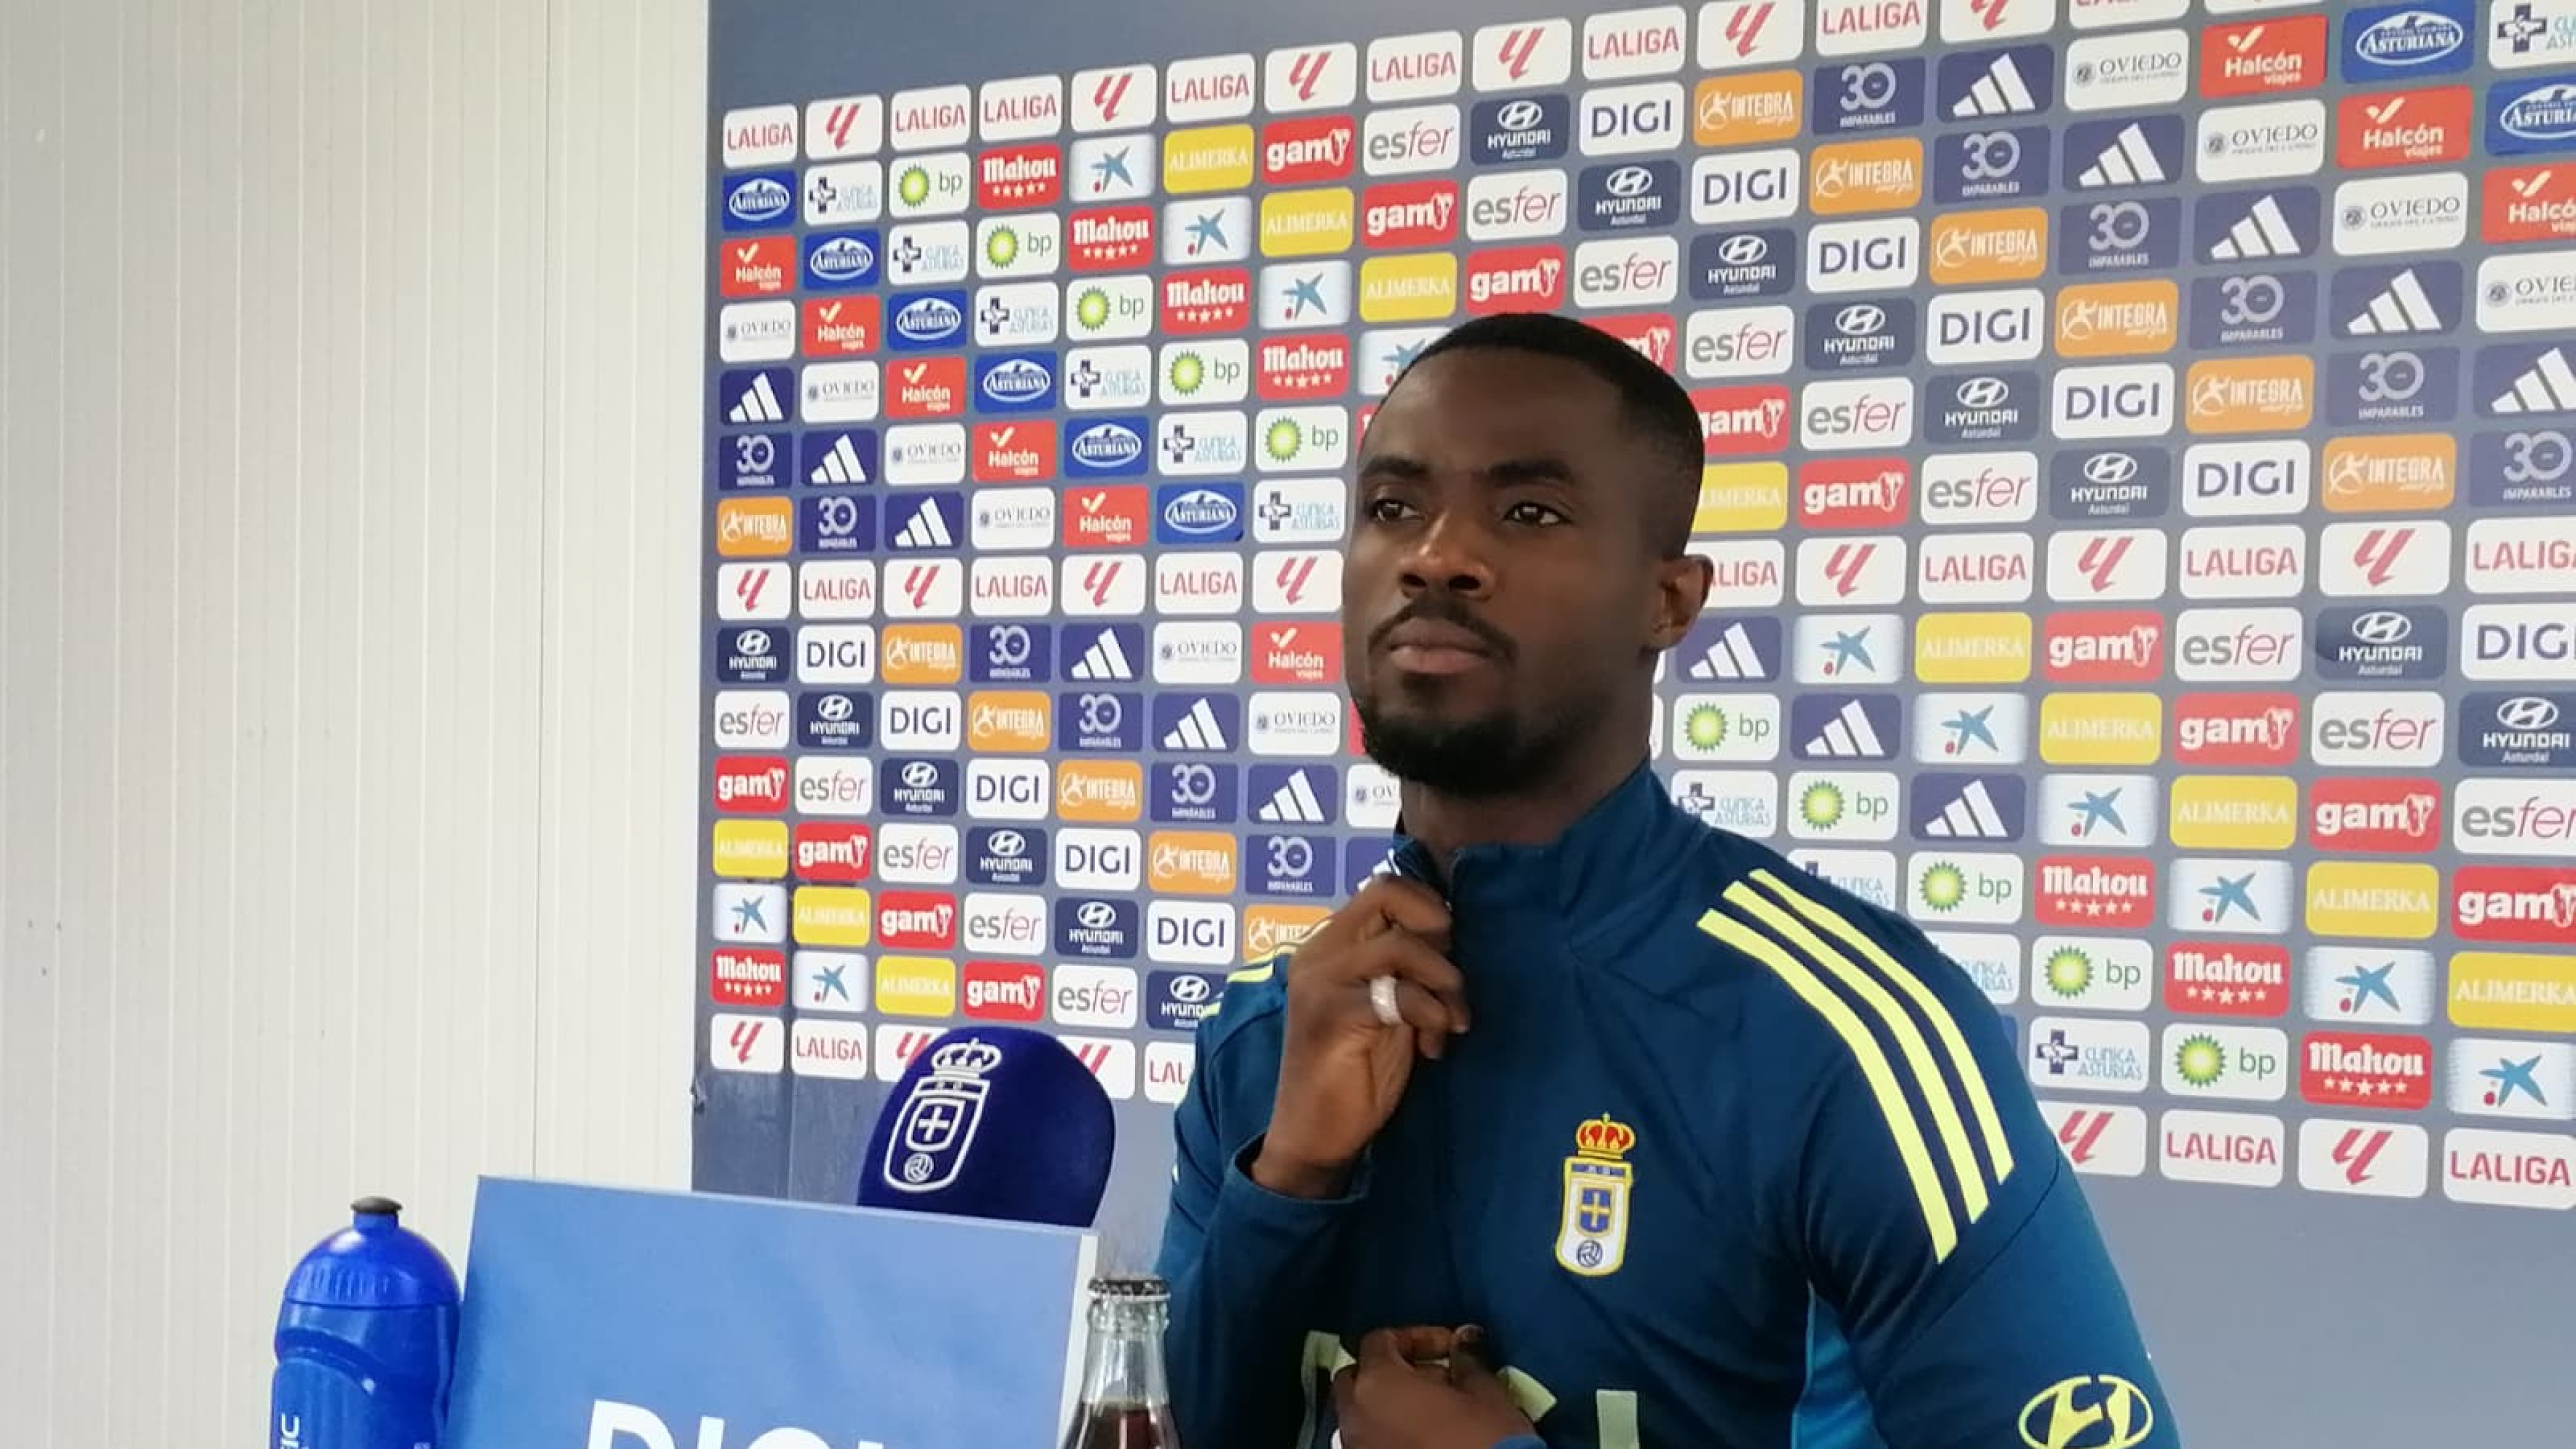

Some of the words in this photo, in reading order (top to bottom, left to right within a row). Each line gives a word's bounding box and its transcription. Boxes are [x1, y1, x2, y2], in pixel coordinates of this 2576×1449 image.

[1823, 1, 1919, 34] LALIGA
[1588, 25, 1680, 60] LALIGA
[1371, 50, 1456, 83] LALIGA
[2100, 52, 2181, 76] OVIEDO
[2224, 48, 2302, 78] Halcón
[1171, 72, 1250, 104] LALIGA
[1840, 61, 1897, 111] 30
[895, 103, 966, 132] LALIGA
[984, 93, 1057, 123] LALIGA
[1592, 100, 1671, 139] DIGI
[1730, 89, 1794, 119] INTEGRA
[727, 122, 793, 150] LALIGA
[1369, 117, 1454, 161] esfer
[1487, 129, 1551, 148] HYUNDAI
[2233, 123, 2317, 146] OVIEDO
[2363, 120, 2445, 150] Halcón
[983, 152, 1055, 182] Mahou
[1962, 129, 2021, 180] 30
[938, 169, 962, 197] bp
[1704, 168, 1786, 206] DIGI
[1848, 157, 1915, 187] INTEGRA
[1473, 183, 1562, 226] esfer
[1596, 196, 1662, 215] HYUNDAI
[2371, 197, 2459, 219] OVIEDO
[1073, 213, 1148, 244] Mahou
[2088, 200, 2150, 251] 30
[1027, 229, 1052, 258] bp
[1820, 236, 1906, 274] DIGI
[1970, 227, 2039, 257] INTEGRA
[1580, 250, 1672, 293] esfer
[1707, 265, 1776, 283] HYUNDAI
[1118, 292, 1144, 320] bp
[1166, 276, 1244, 307] Mahou
[2220, 274, 2285, 325] 30
[1940, 308, 2029, 345] DIGI
[2097, 300, 2169, 329] INTEGRA
[1263, 342, 1344, 372] Mahou
[1692, 321, 1787, 363] esfer
[1824, 336, 1895, 354] HYUNDAI
[1214, 356, 1240, 384] bp
[2358, 350, 2425, 402] 30
[2066, 383, 2159, 421] DIGI
[2229, 376, 2305, 405] INTEGRA
[1807, 392, 1907, 435] esfer
[1945, 409, 2019, 427] HYUNDAI
[1311, 423, 1339, 451] bp
[737, 434, 773, 472] 30
[2503, 430, 2573, 482] 30
[2197, 460, 2294, 497] DIGI
[2367, 455, 2446, 484] INTEGRA
[1928, 466, 2031, 508] esfer
[2070, 486, 2147, 502] HYUNDAI
[818, 496, 857, 535] 30
[1925, 554, 2027, 582] LALIGA
[2186, 547, 2298, 576] LALIGA
[803, 578, 871, 600] LALIGA
[975, 575, 1048, 598] LALIGA
[1160, 571, 1238, 595] LALIGA
[806, 641, 865, 667] DIGI
[989, 625, 1031, 663] 30
[2183, 624, 2295, 665] esfer
[2339, 646, 2422, 661] HYUNDAI
[719, 704, 785, 735] esfer
[890, 707, 951, 735] DIGI
[1079, 694, 1122, 733] 30
[1738, 713, 1770, 743] bp
[2319, 708, 2436, 750] esfer
[2483, 733, 2570, 749] HYUNDAI
[800, 769, 867, 802] esfer
[976, 774, 1039, 803] DIGI
[1171, 763, 1216, 804] 30
[1856, 791, 1889, 821] bp
[883, 836, 953, 870] esfer
[1065, 845, 1130, 875] DIGI
[1267, 836, 1313, 877] 30
[1978, 873, 2012, 904] bp
[2042, 865, 2148, 897] Mahou
[969, 906, 1042, 941] esfer
[1157, 917, 1224, 948] DIGI
[716, 955, 781, 981] Mahou
[2105, 958, 2141, 990] bp
[2172, 951, 2282, 985] Mahou
[1057, 977, 1133, 1014] esfer
[796, 1036, 863, 1061] LALIGA
[2238, 1047, 2276, 1080] bp
[2308, 1040, 2423, 1077] Mahou
[2167, 1130, 2277, 1165] LALIGA
[2449, 1150, 2570, 1187] LALIGA
[280, 1413, 301, 1449] IC
